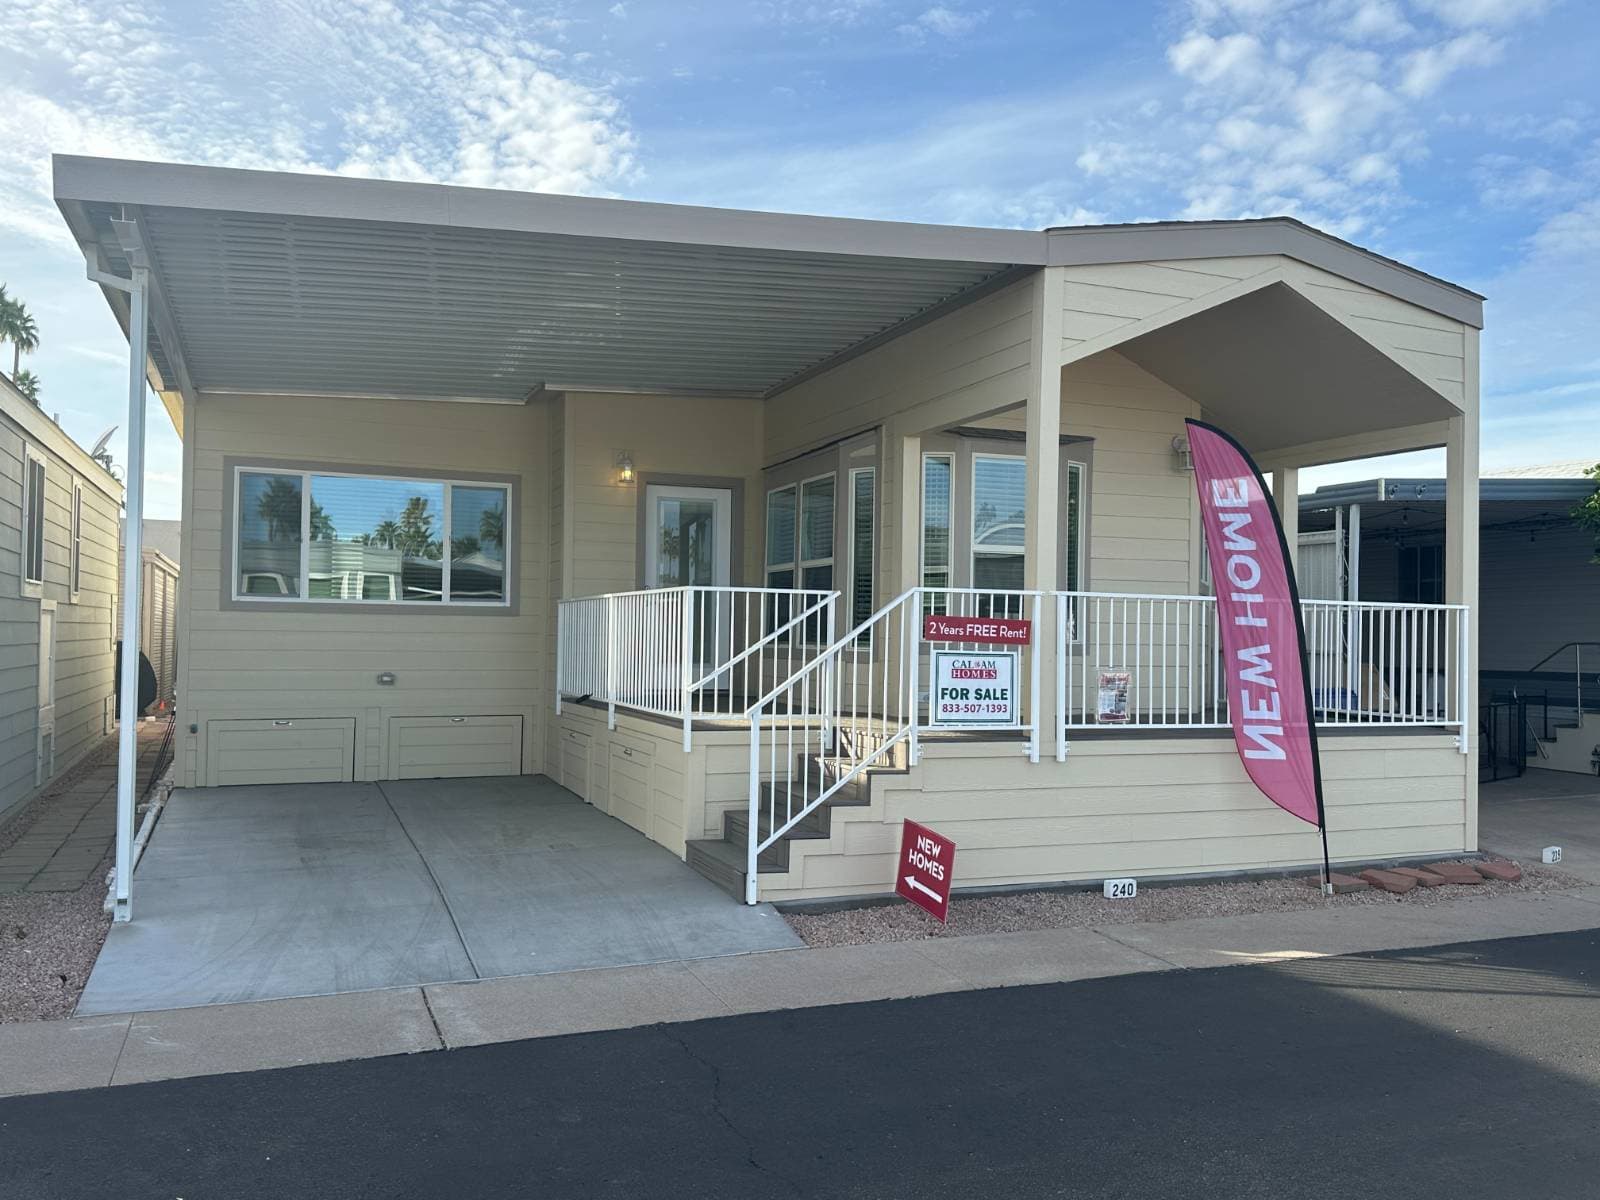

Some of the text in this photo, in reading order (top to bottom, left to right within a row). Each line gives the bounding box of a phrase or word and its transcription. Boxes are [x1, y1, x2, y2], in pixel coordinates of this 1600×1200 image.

[929, 621, 1027, 638] 2 Years FREE Rent!
[952, 660, 974, 669] CAL
[953, 669, 996, 678] HOMES
[941, 687, 1009, 701] FOR SALE
[942, 703, 1008, 713] 833-507-1393
[916, 834, 942, 859] NEW
[908, 847, 945, 881] HOMES
[1112, 883, 1134, 897] 240
